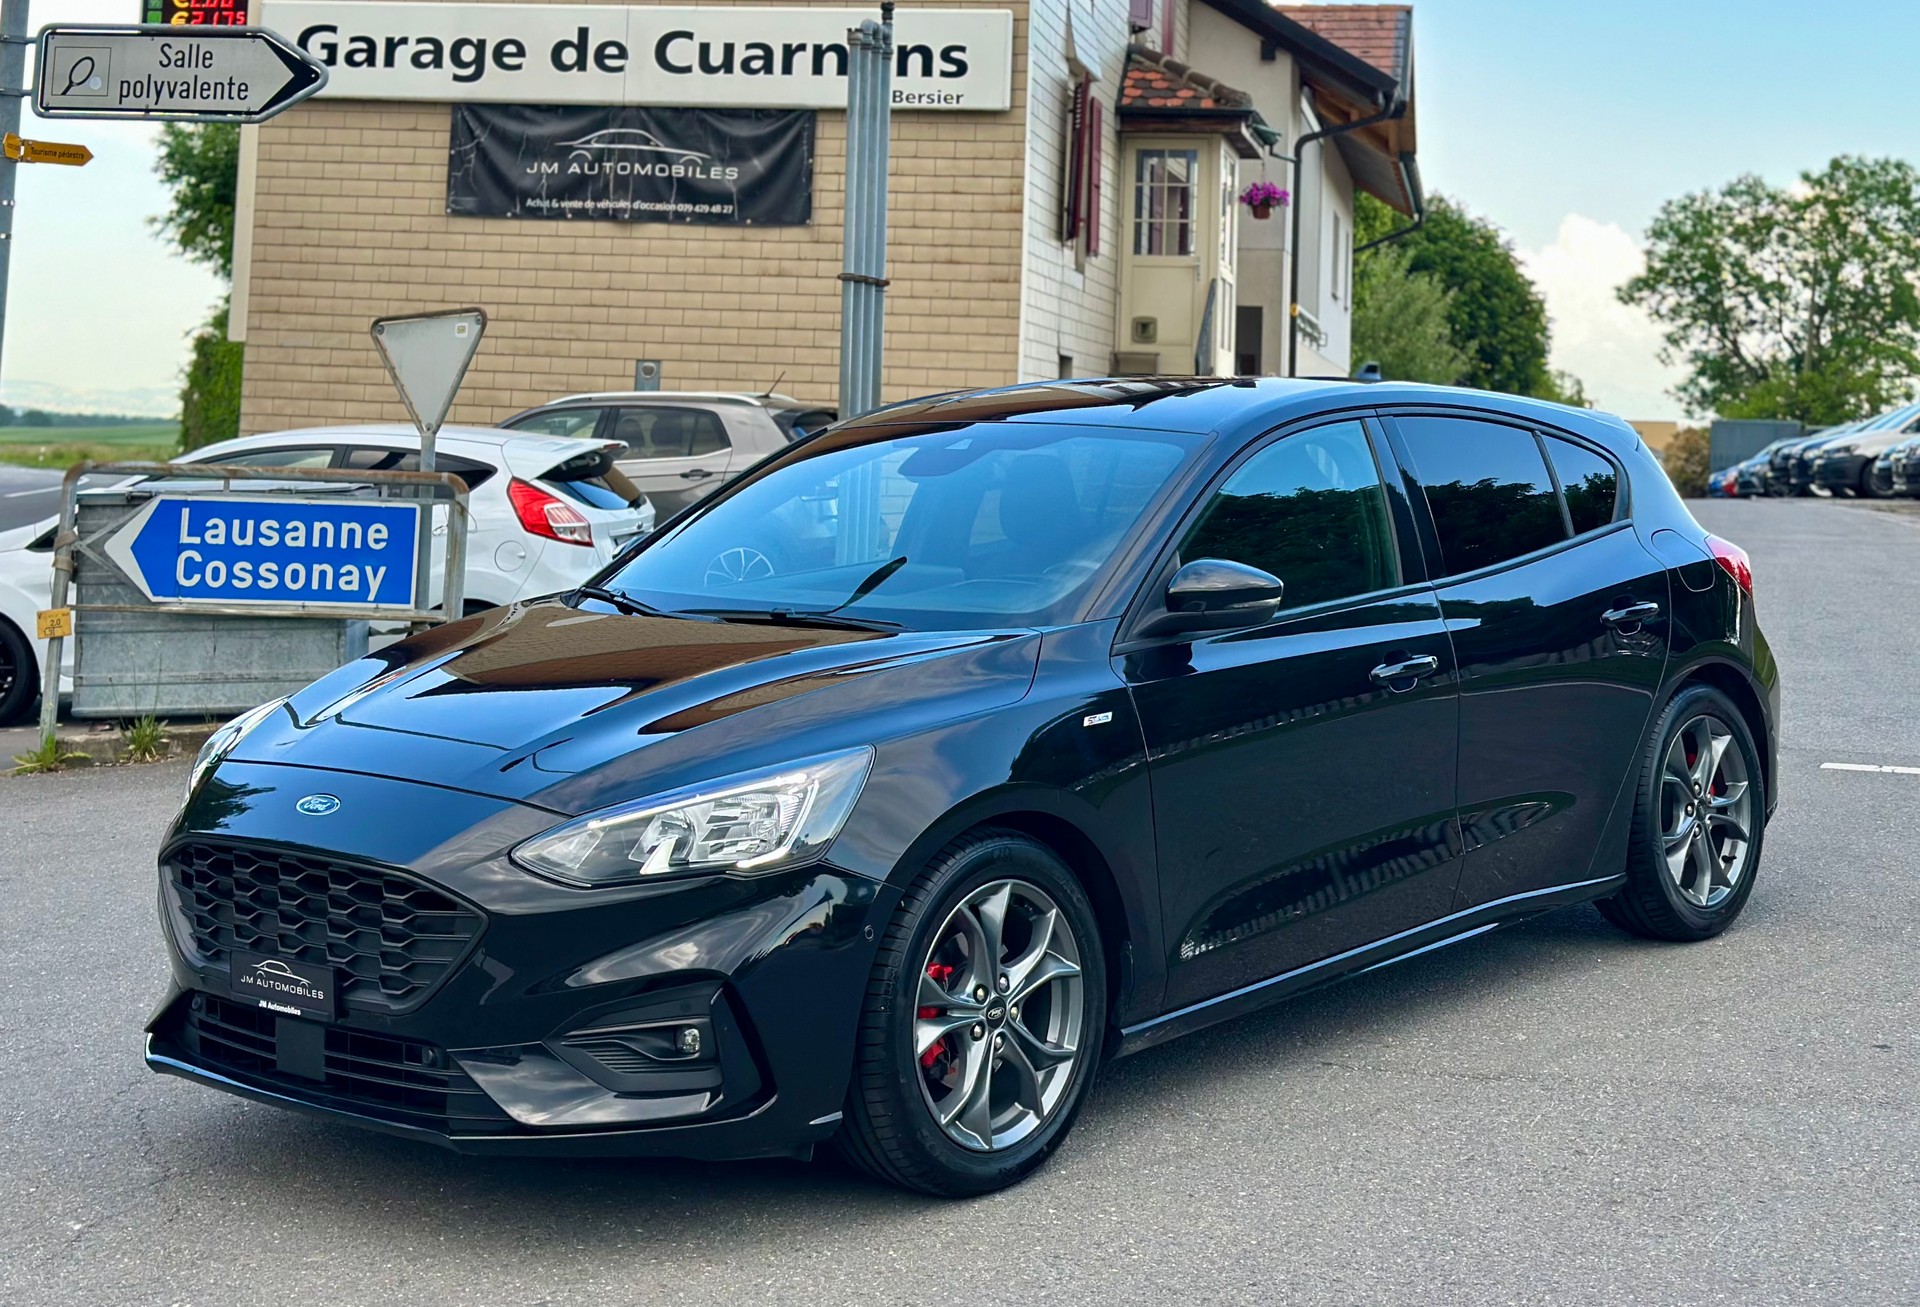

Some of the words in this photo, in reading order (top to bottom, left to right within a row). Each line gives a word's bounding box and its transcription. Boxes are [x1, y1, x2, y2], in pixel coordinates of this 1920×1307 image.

[159, 43, 214, 69] Salle
[296, 24, 527, 83] Garage
[550, 26, 629, 73] de
[654, 30, 969, 79] Cuarnns
[119, 73, 249, 106] polyvalente
[892, 90, 964, 104] Bersier
[31, 147, 57, 157] Tourisme
[526, 162, 559, 174] JM
[568, 162, 738, 180] AUTOMOBILES
[525, 198, 550, 208] Achat
[560, 200, 582, 209] vente
[584, 199, 595, 209] de
[596, 199, 631, 210] véhicules
[632, 200, 676, 212] d'occasion
[677, 203, 693, 213] 079
[694, 204, 709, 213] 429
[722, 205, 733, 214] 27
[180, 507, 389, 550] Lausanne
[176, 550, 388, 602] Cossonay
[240, 975, 254, 984] JM
[256, 978, 324, 1000] AUTOMOBILES
[259, 1000, 267, 1008] JM
[267, 1001, 302, 1016] Automobiles
